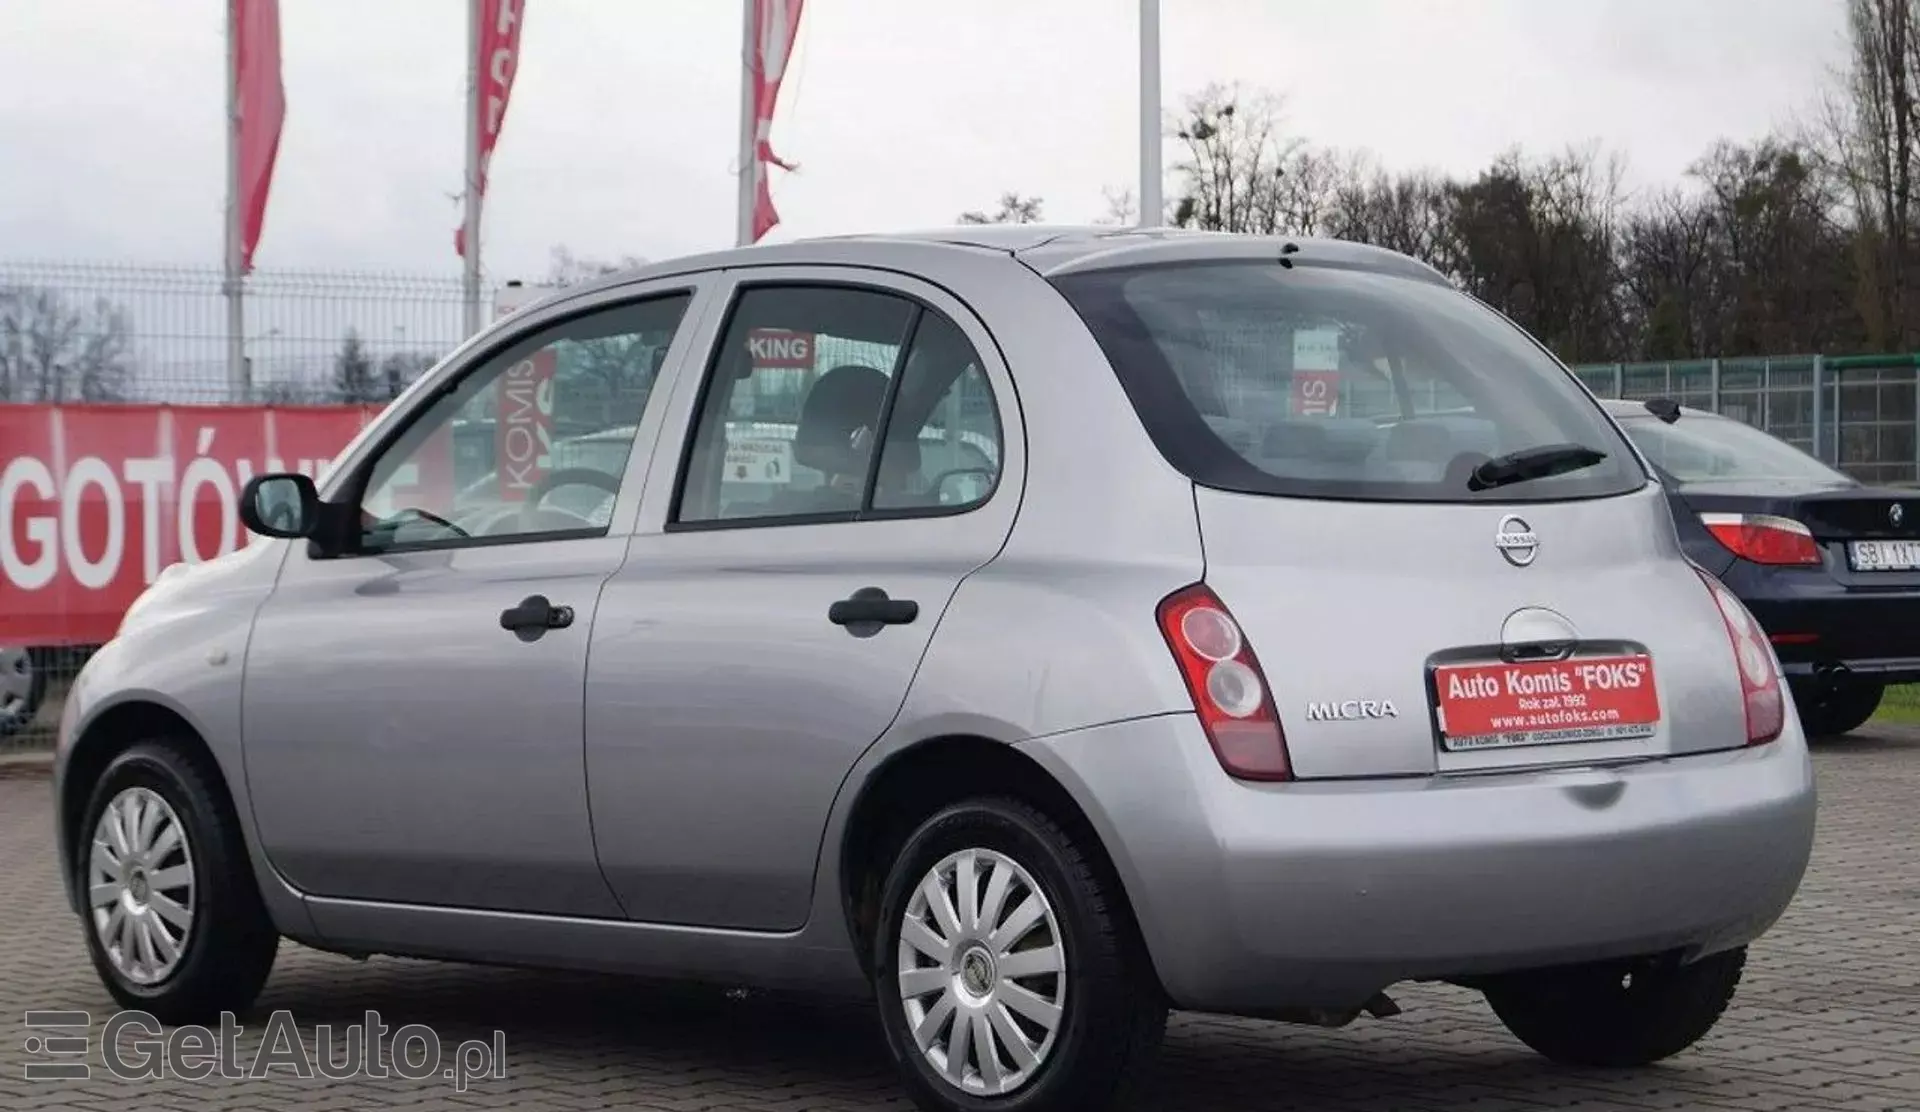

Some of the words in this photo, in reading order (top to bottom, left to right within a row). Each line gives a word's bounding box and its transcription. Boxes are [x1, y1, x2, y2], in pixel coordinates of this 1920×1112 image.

[505, 358, 535, 488] KOMIS
[1448, 672, 1500, 700] Auto
[1506, 669, 1571, 696] Komis
[1575, 662, 1646, 690] "FOKS"
[1306, 699, 1400, 721] MICRA
[1518, 696, 1543, 711] Rok
[1562, 693, 1588, 707] 1992
[1489, 708, 1620, 730] www.autofoks.com
